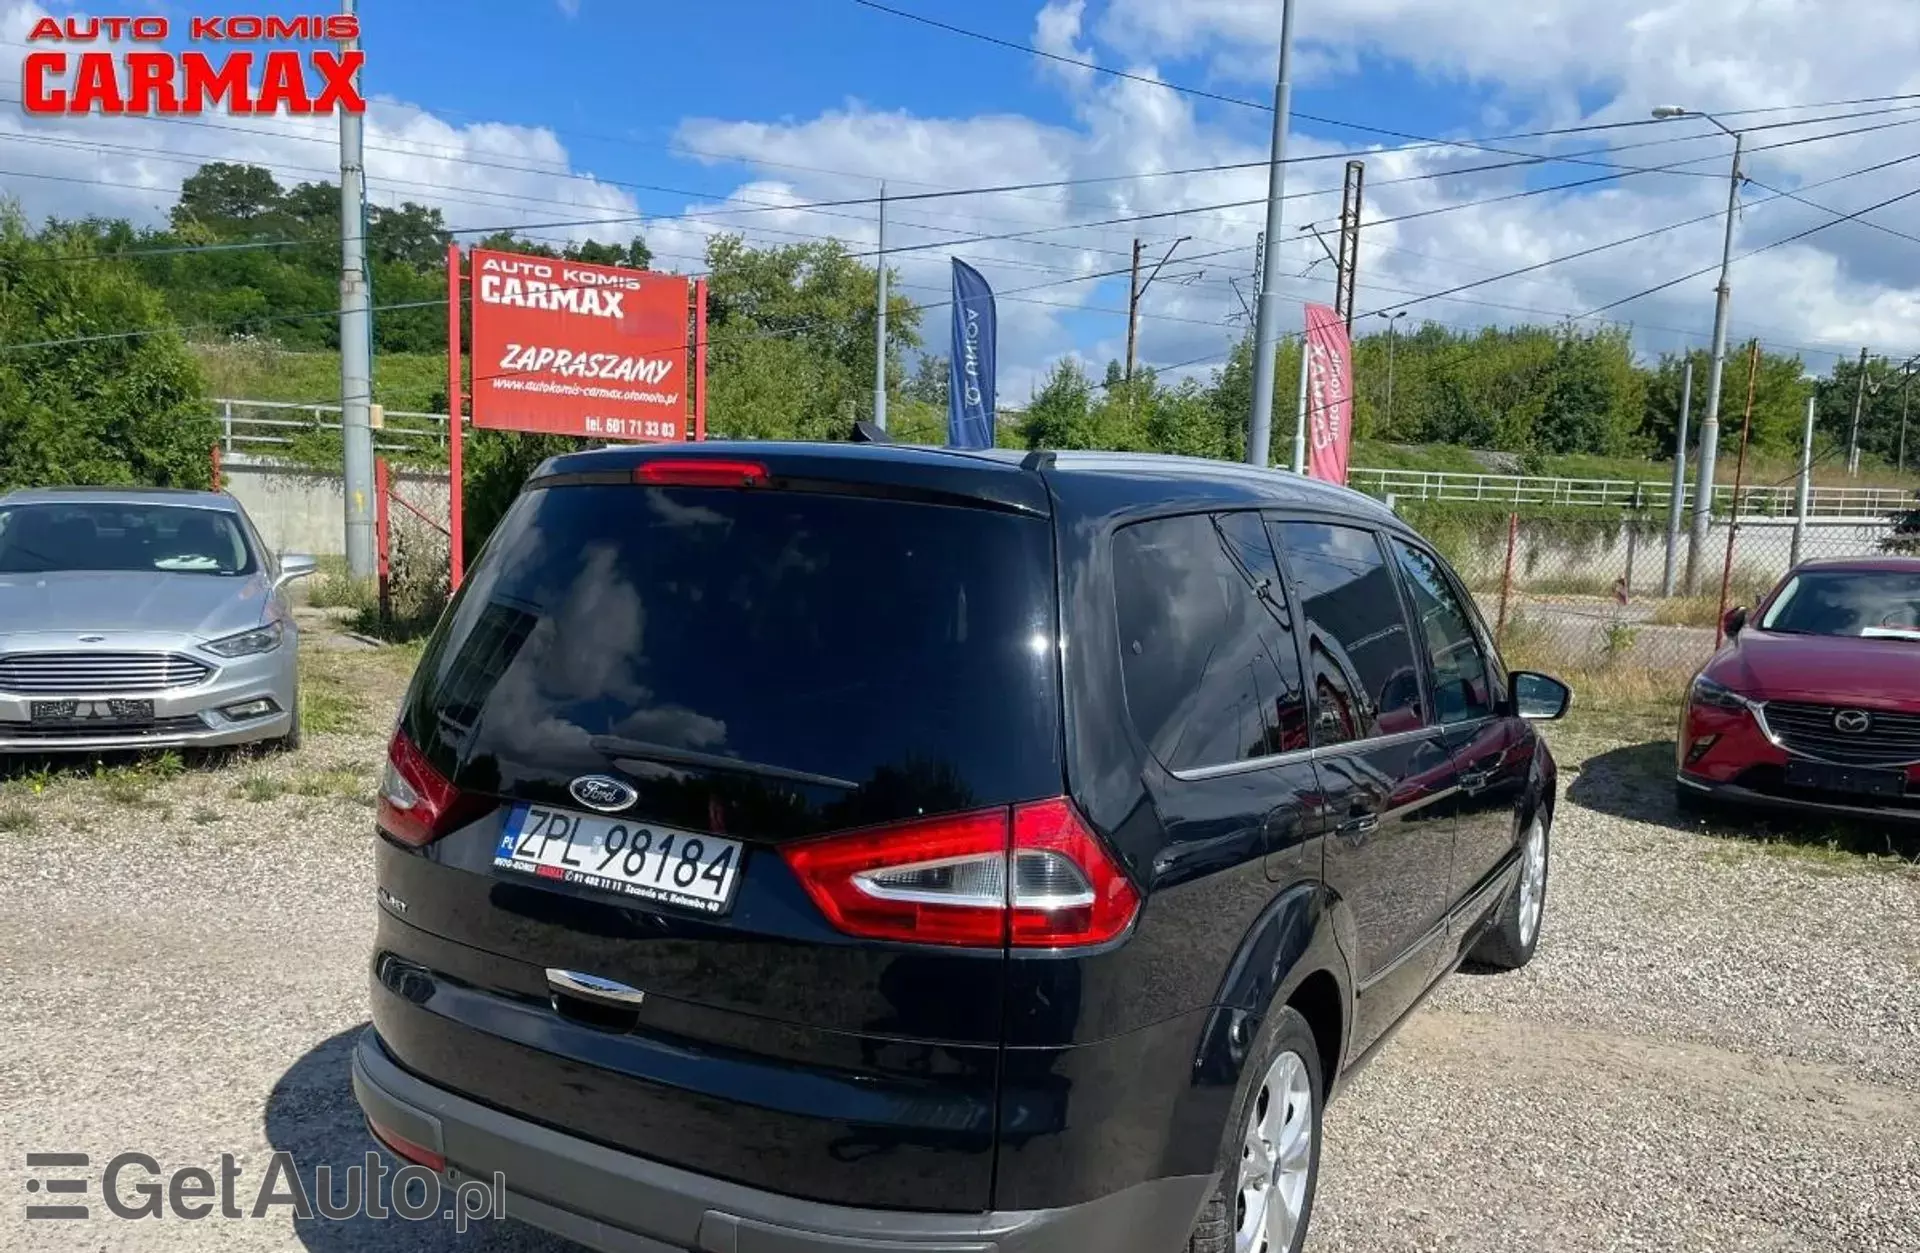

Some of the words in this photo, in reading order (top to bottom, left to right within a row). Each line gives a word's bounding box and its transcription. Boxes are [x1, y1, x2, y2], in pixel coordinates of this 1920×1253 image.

[482, 258, 552, 278] AUTO
[563, 269, 641, 290] KOMIS
[481, 275, 624, 318] CARMAX
[500, 344, 673, 385] ZAPRASZAMY
[493, 378, 678, 406] www.autokomis-carmax.otomoto.pl
[585, 416, 602, 432] tel.
[606, 418, 626, 434] 601
[629, 420, 642, 435] 71
[645, 421, 659, 436] 33
[582, 781, 618, 802] Ford
[501, 836, 515, 850] PL
[516, 809, 583, 867] ZPL
[597, 824, 735, 895] 98184
